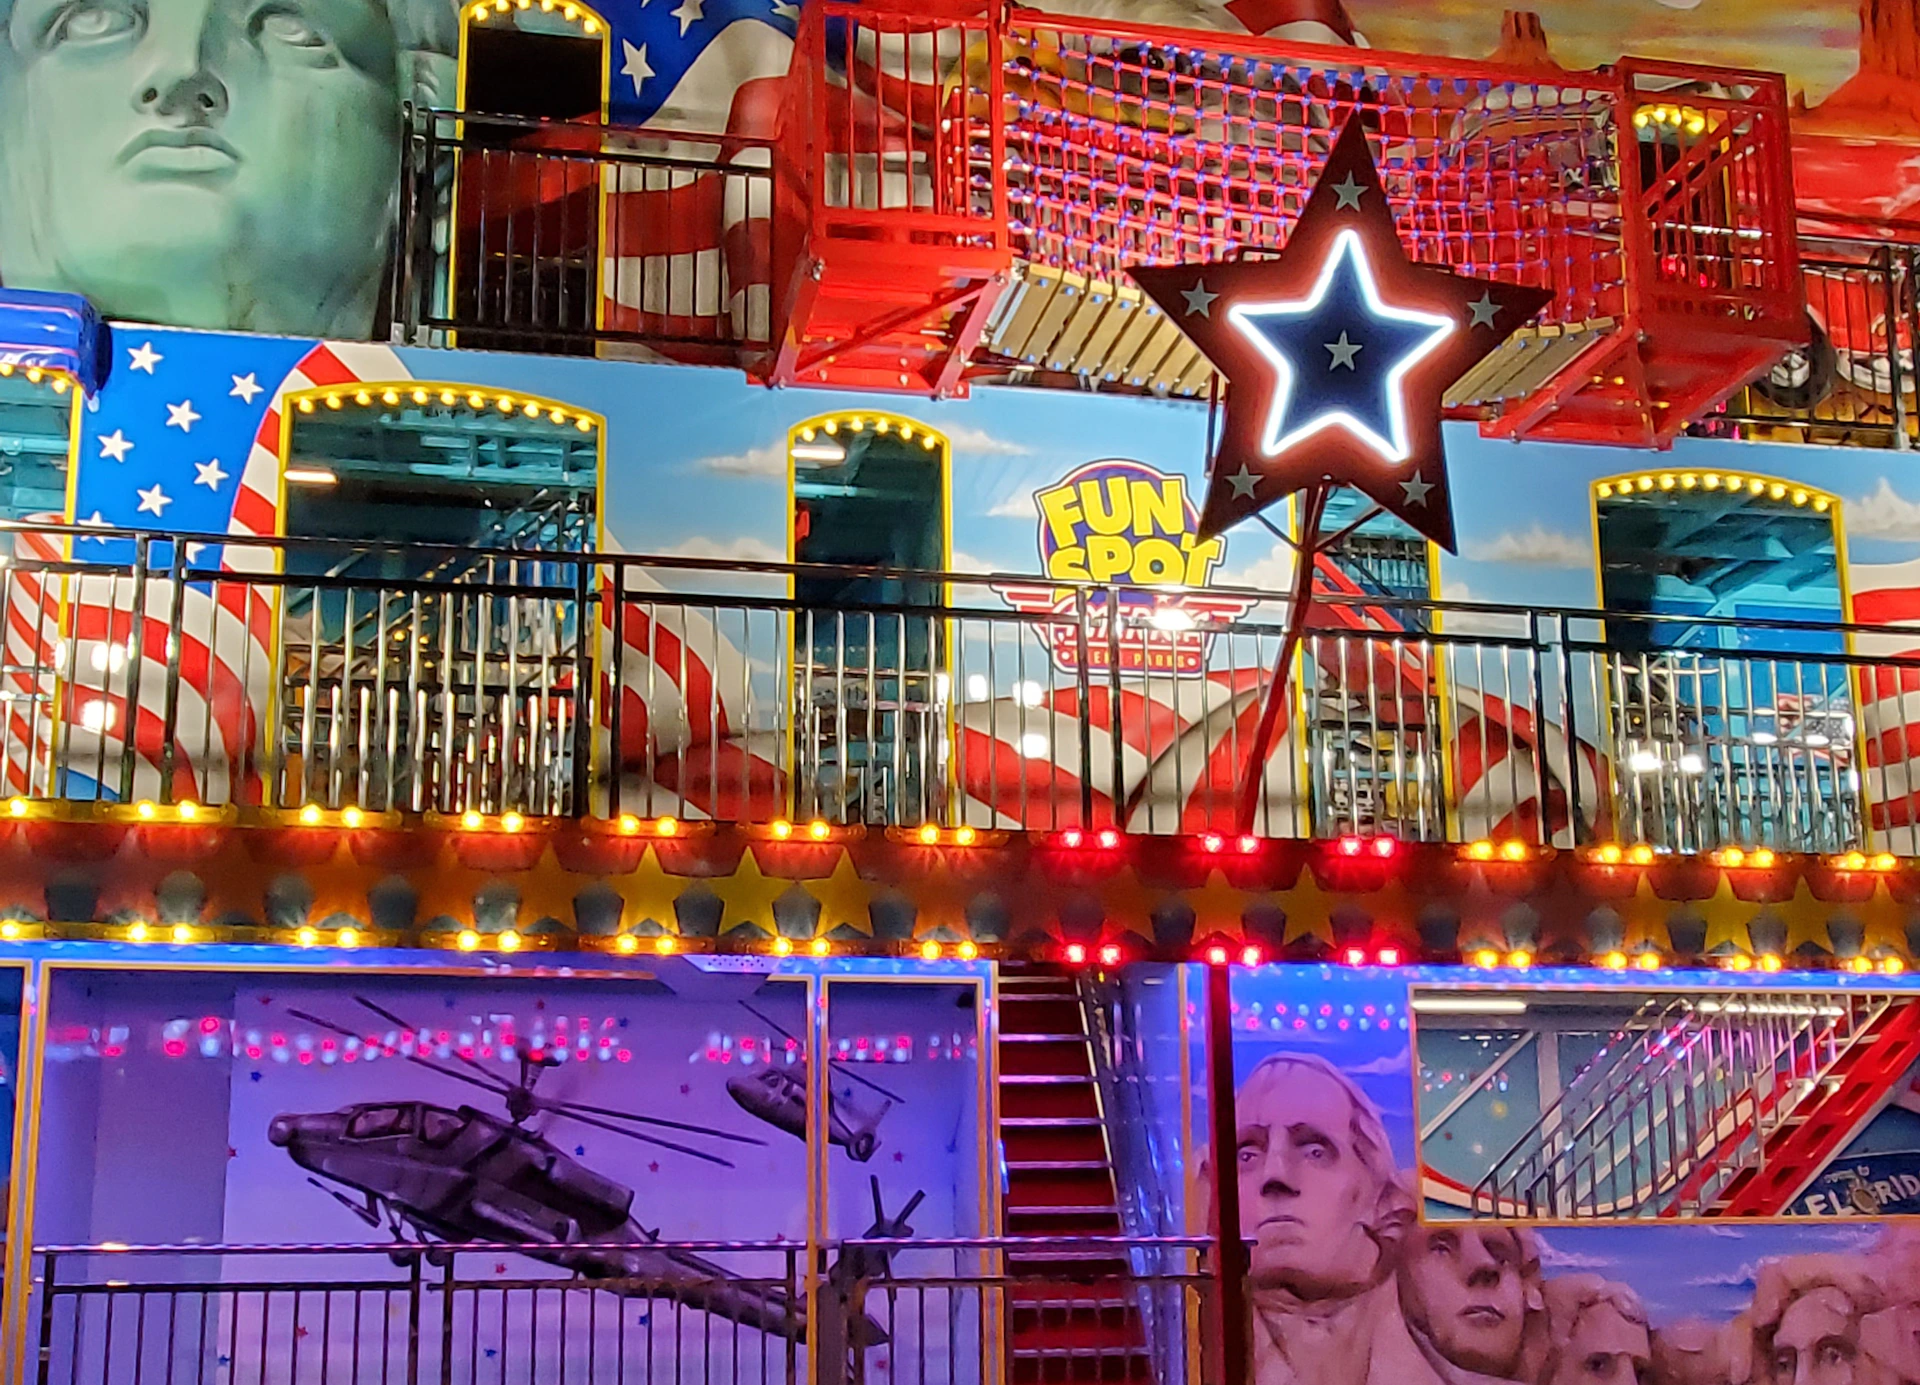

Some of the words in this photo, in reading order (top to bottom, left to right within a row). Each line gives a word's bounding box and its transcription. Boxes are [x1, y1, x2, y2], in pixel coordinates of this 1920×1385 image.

[1041, 476, 1185, 549] FUN
[1049, 532, 1221, 604] SPOT
[1052, 595, 1210, 643] AMERA
[1804, 1168, 1920, 1217] FLORID
